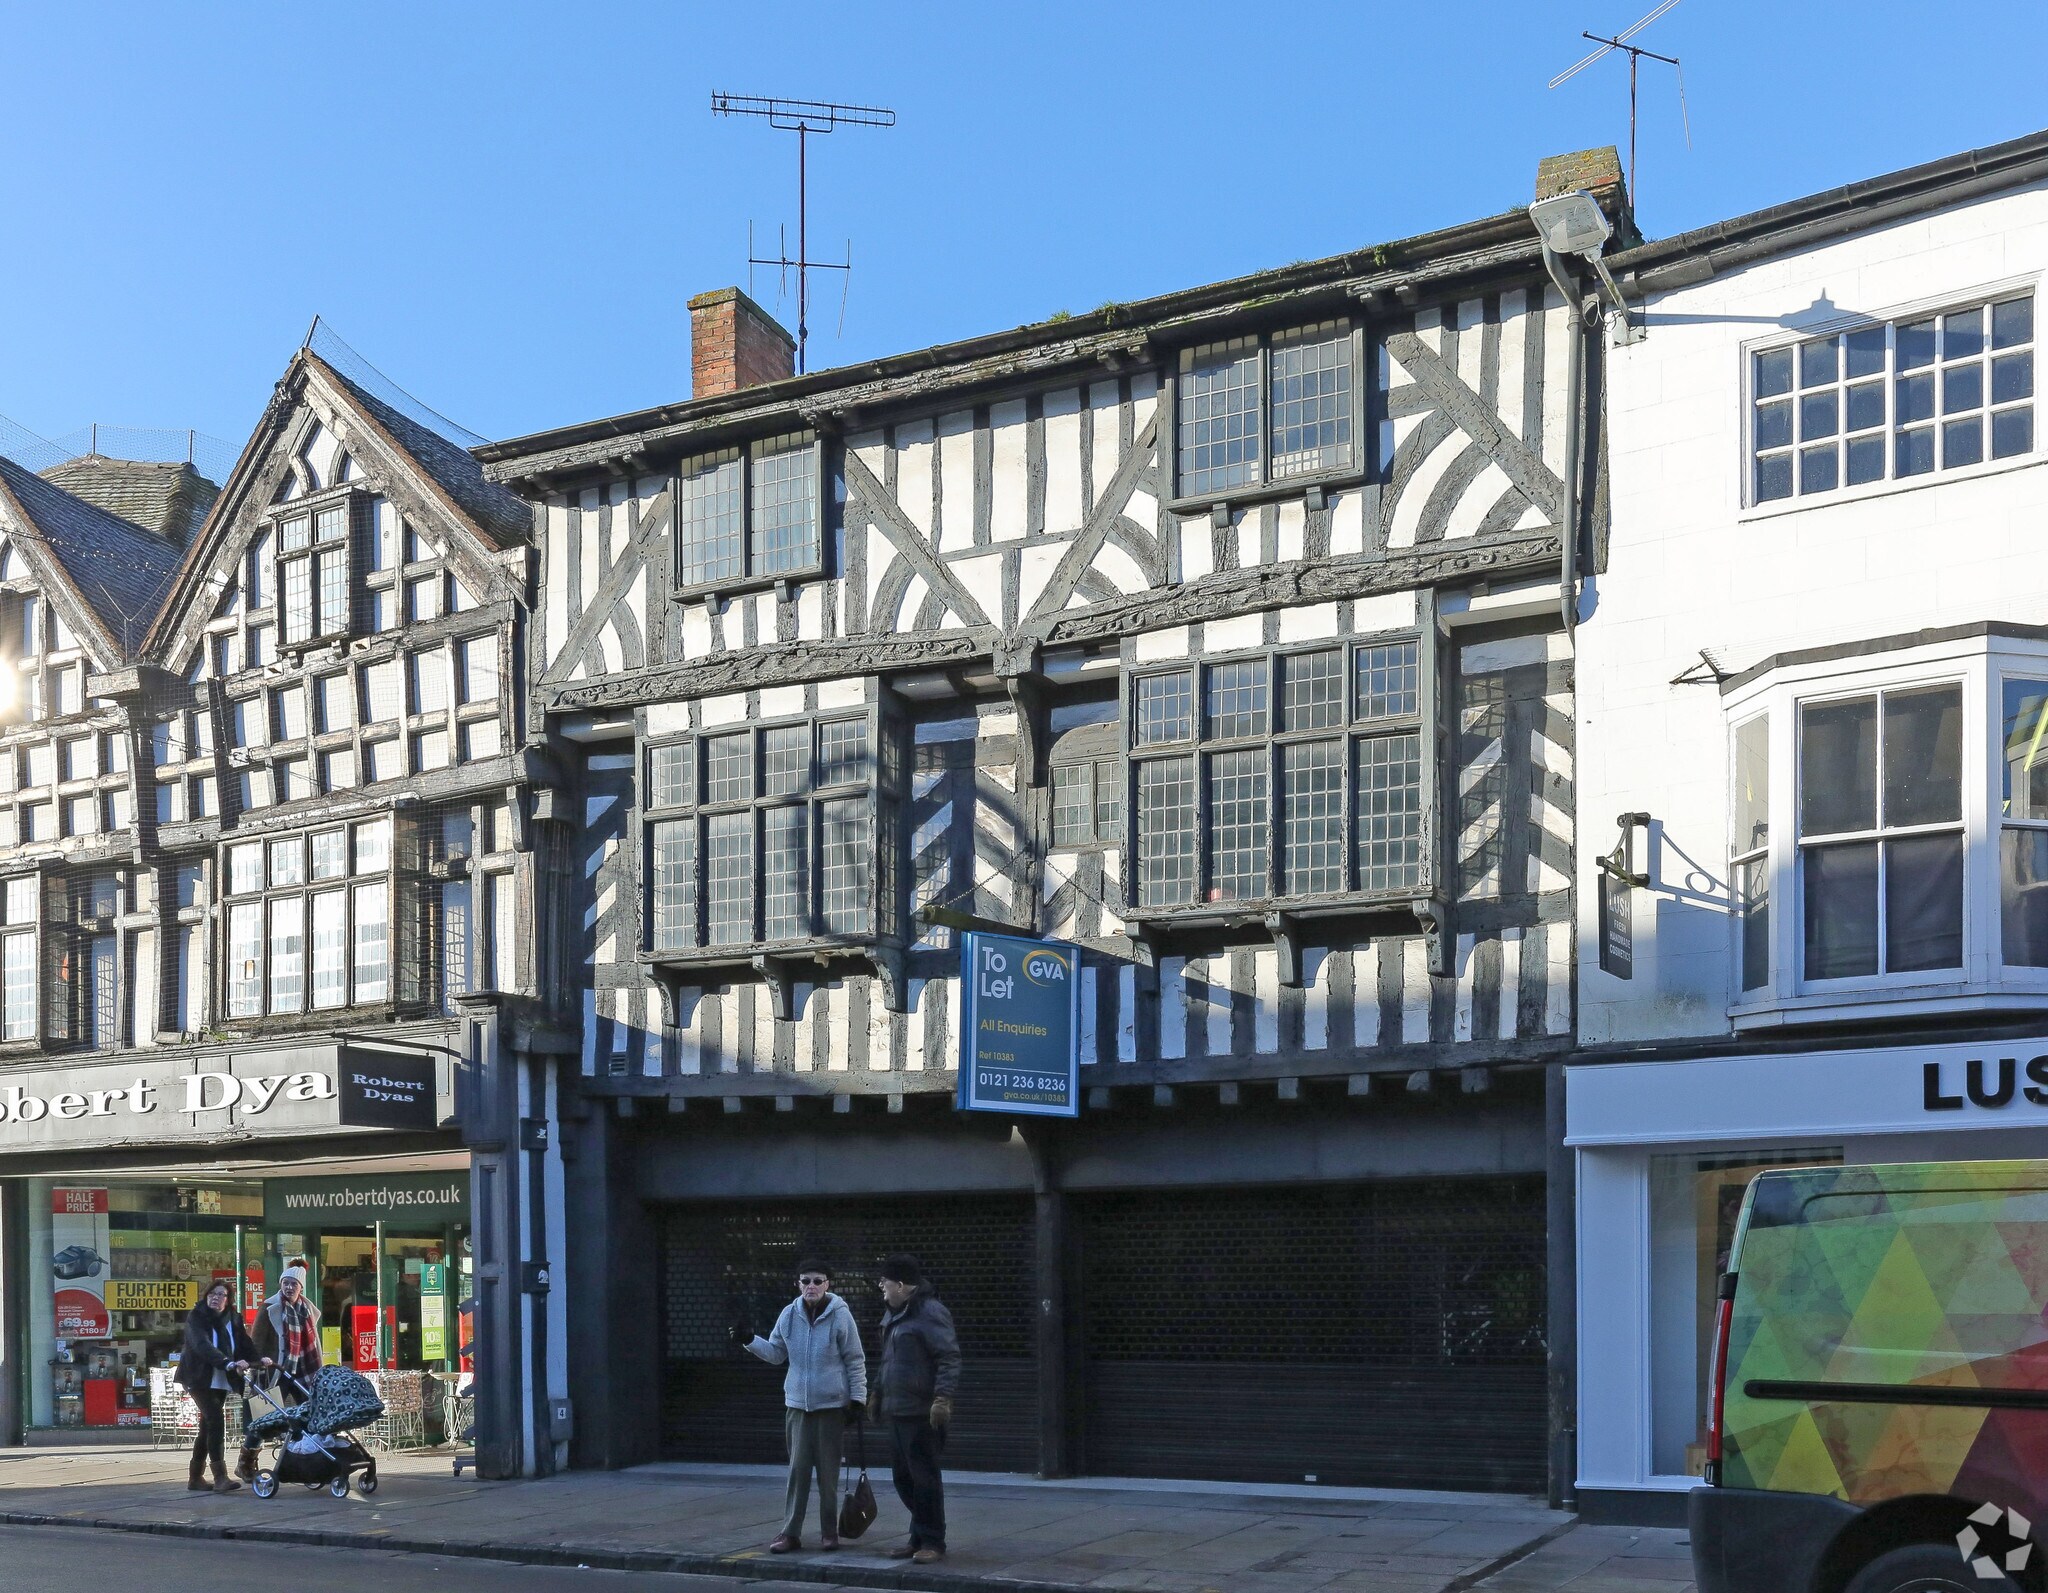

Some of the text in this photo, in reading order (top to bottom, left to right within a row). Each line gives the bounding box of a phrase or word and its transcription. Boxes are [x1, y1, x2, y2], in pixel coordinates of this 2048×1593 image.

[1609, 891, 1630, 920] LUSH
[1613, 920, 1627, 933] FRESH
[982, 946, 1007, 973] To
[1609, 943, 1631, 962] COSMETICS
[1029, 960, 1064, 980] GVA
[981, 972, 1014, 999] Let
[980, 1018, 1047, 1036] All Enquiries
[979, 1051, 1015, 1062] Ref 10383
[352, 1073, 425, 1091] Robert
[980, 1072, 1066, 1091] 0121 236 8236
[1923, 1054, 2048, 1111] LUS
[0, 1070, 339, 1123] bert Dya
[364, 1088, 414, 1103] Dyas
[66, 1192, 94, 1203] HALF
[285, 1184, 460, 1210] www.robertdyas.co.uk
[66, 1203, 95, 1212] PRICE
[116, 1282, 186, 1297] FURTHER
[245, 1282, 264, 1291] RICE
[116, 1298, 187, 1309] REDUCTIONS
[58, 1317, 96, 1328] £69.99
[360, 1337, 376, 1345] HALF
[559, 1409, 564, 1418] 4
